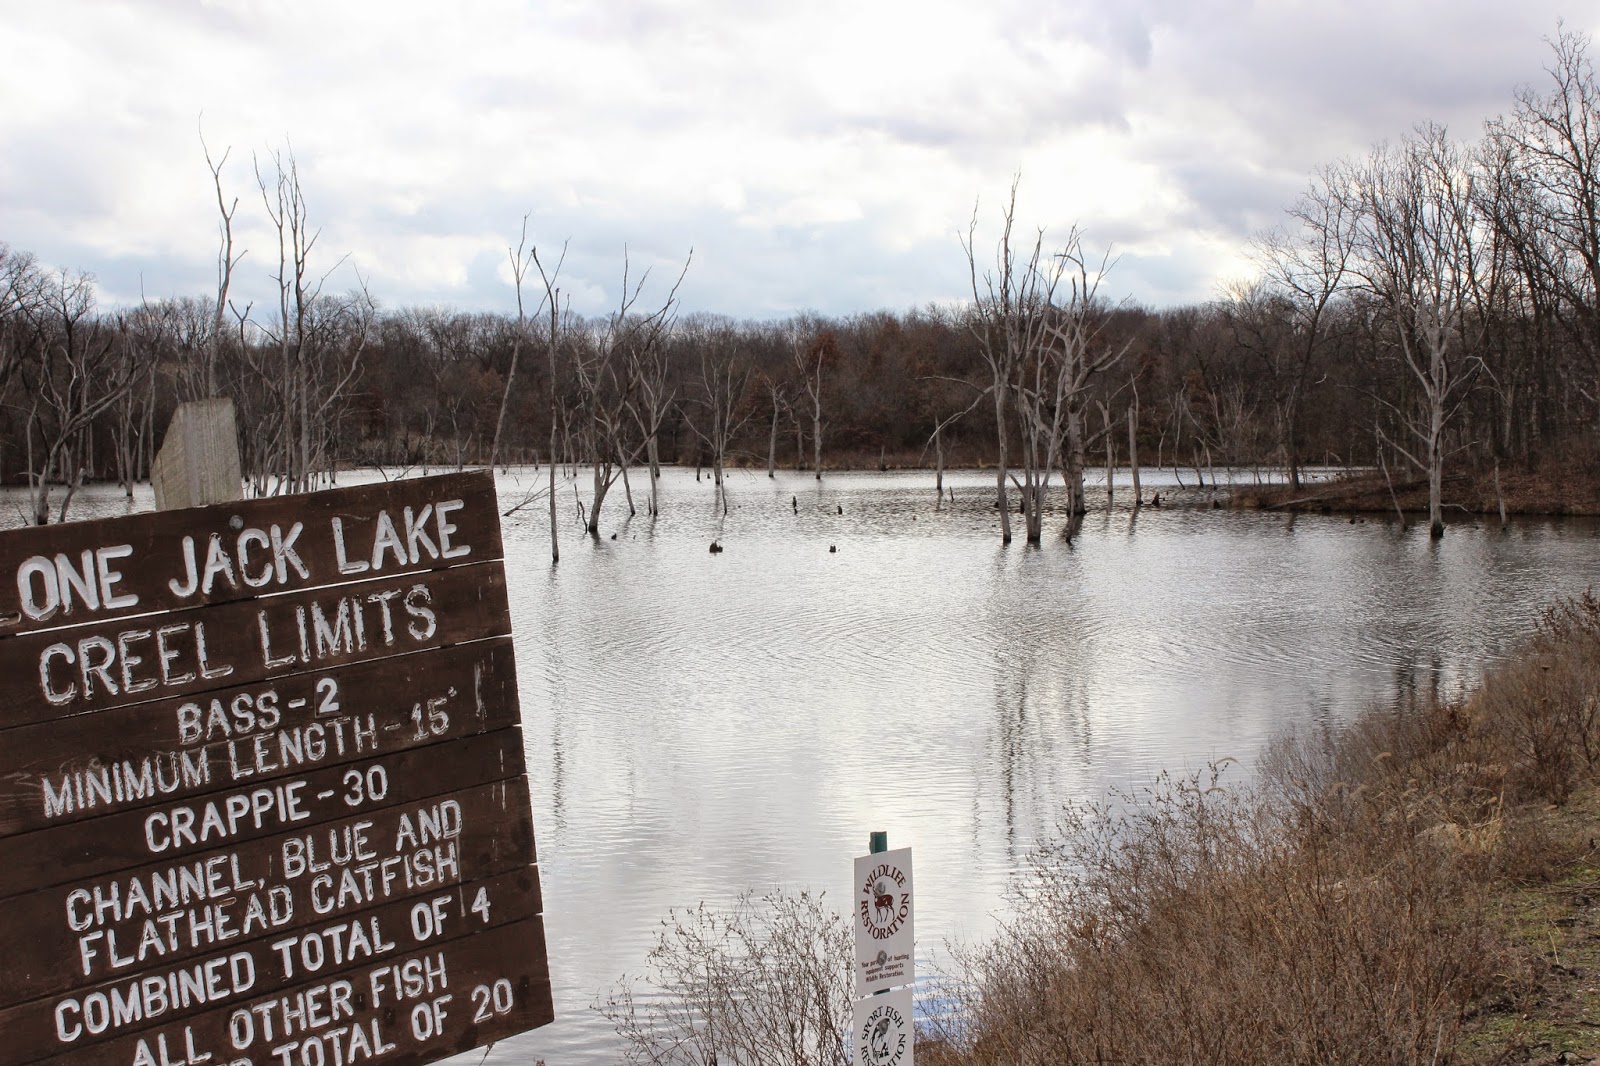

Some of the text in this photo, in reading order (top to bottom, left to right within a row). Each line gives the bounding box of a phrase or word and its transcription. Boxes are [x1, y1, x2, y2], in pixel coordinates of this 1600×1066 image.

[168, 521, 310, 599] JACK
[331, 499, 471, 575] LAKE
[39, 583, 438, 706] CREEL LIMITS
[41, 746, 211, 819] MINIMUM
[282, 820, 377, 879] BLUE
[395, 799, 463, 851] AND
[863, 864, 907, 895] WILDLIFE
[80, 843, 459, 976] FLATHEAD CATFISH
[861, 892, 910, 940] RESTORATION
[55, 886, 491, 1043] COMBINED TOTAL OF 4
[133, 952, 448, 1066] ALL OTHER FISH
[271, 978, 514, 1066] TOTAL OF 20
[862, 1005, 905, 1041] SPORT FISH
